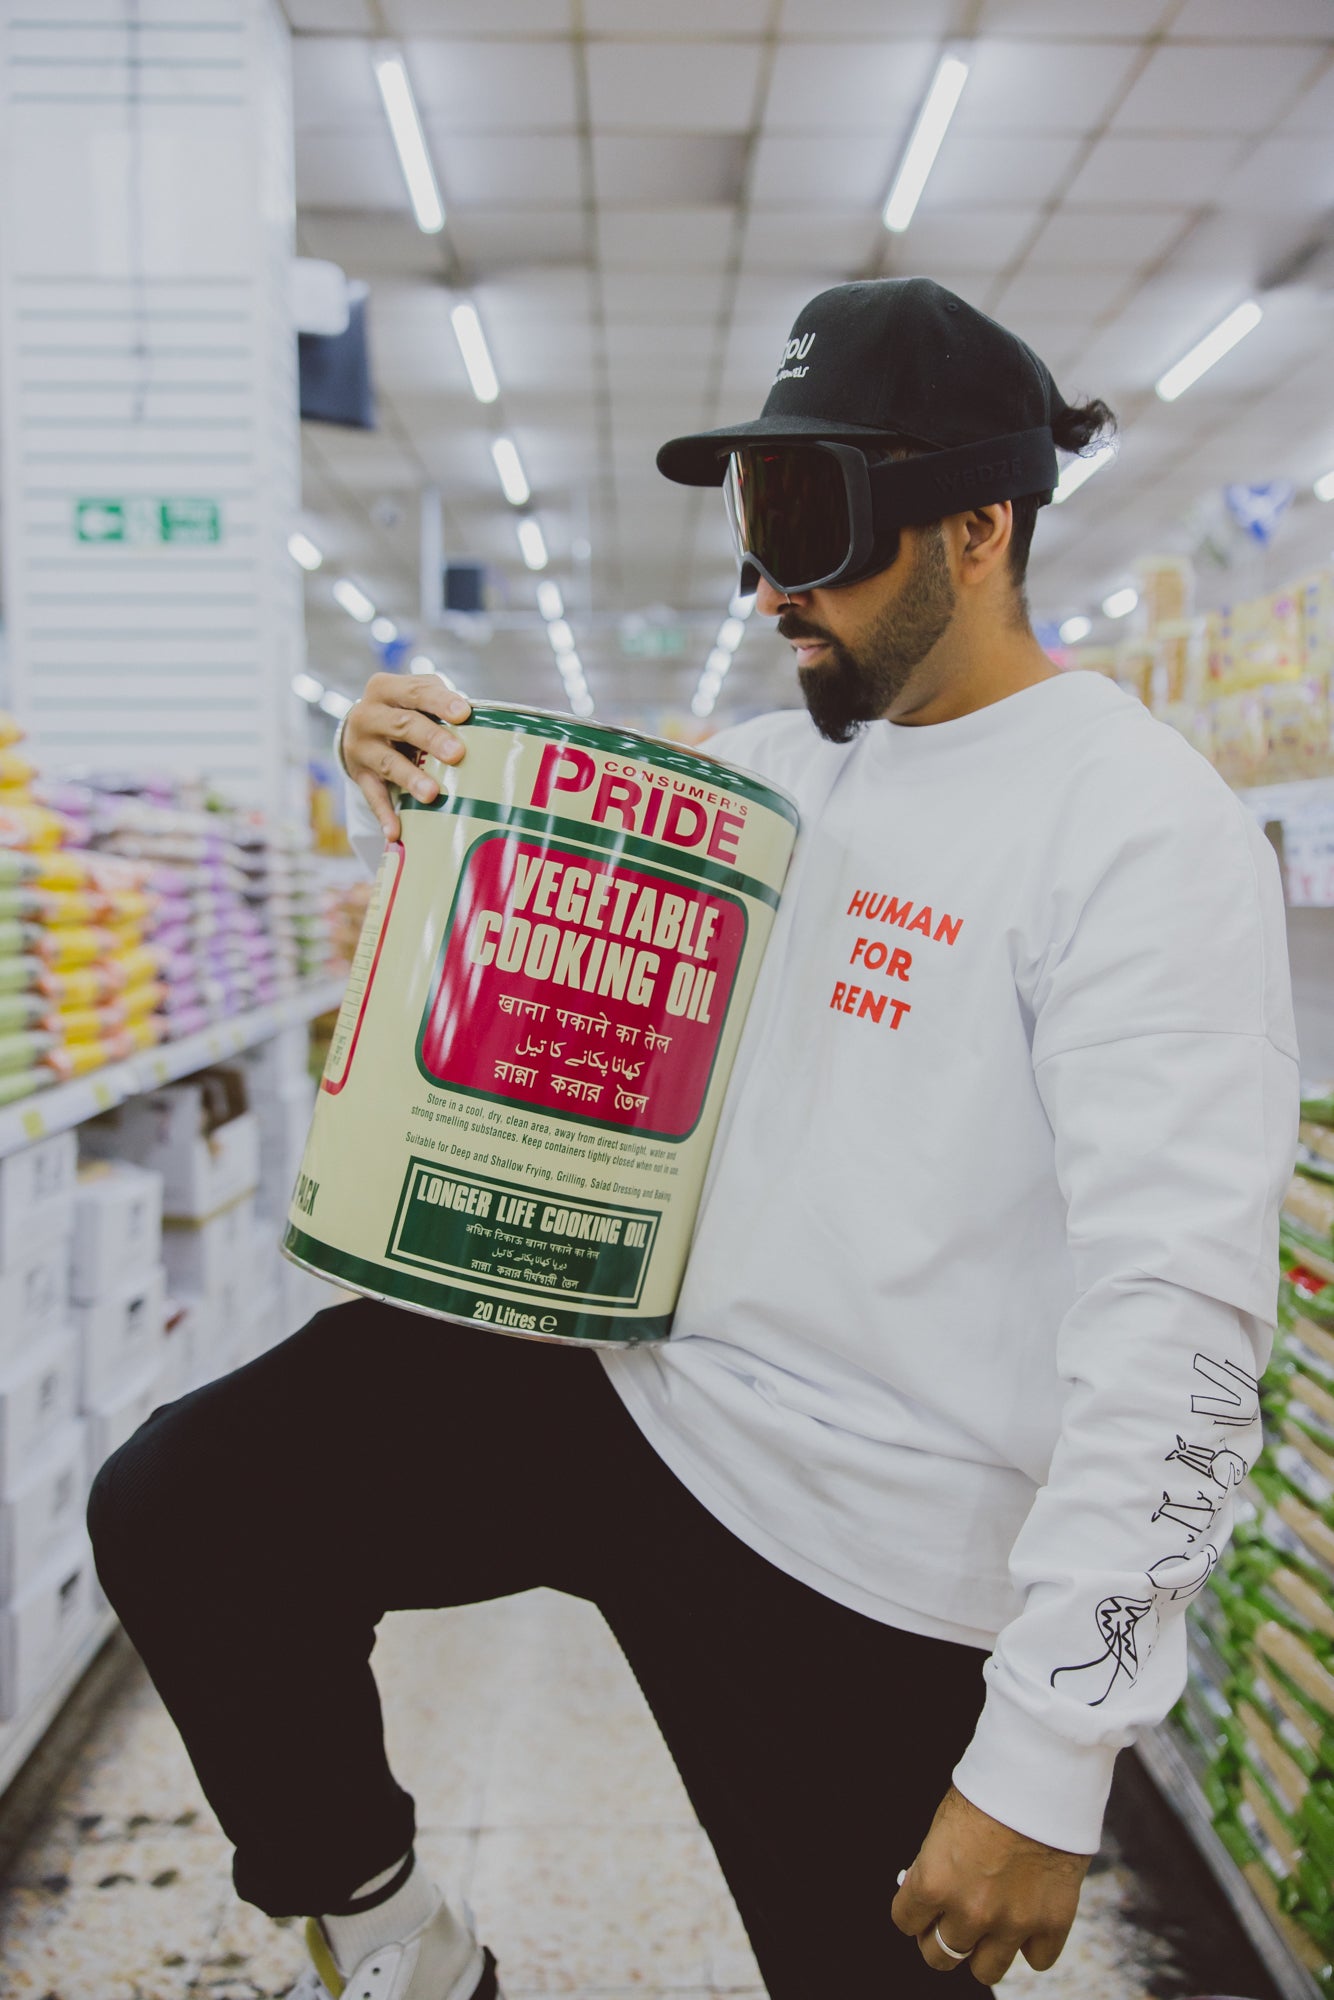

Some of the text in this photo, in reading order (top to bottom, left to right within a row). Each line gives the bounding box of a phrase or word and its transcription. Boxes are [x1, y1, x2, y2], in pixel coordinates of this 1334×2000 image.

[530, 743, 745, 865] PRIDE
[603, 761, 748, 816] CONSUMER'S
[512, 853, 719, 961] VEGETABLE
[847, 890, 964, 945] HUMAN
[467, 910, 661, 1008] COOKING
[665, 961, 717, 1024] OIL
[850, 938, 912, 982] FOR
[498, 994, 673, 1054] खाना पकाने का तेल
[830, 981, 911, 1030] RENT
[494, 1060, 650, 1114] রান্না করার তৈল
[411, 1105, 434, 1121] strong
[436, 1113, 469, 1131] smelling
[522, 1134, 543, 1148] Keep
[545, 1141, 585, 1158] containers
[588, 1149, 611, 1165] tightly
[613, 1156, 635, 1168] closed
[636, 1161, 652, 1172] when
[427, 1093, 446, 1107] Store
[449, 1100, 456, 1110] in
[506, 1115, 529, 1129] clean
[555, 1128, 575, 1141] away
[578, 1132, 595, 1144] from
[597, 1136, 618, 1150] direct
[406, 1132, 435, 1149] Suitable
[438, 1140, 448, 1152] for
[451, 1144, 471, 1160] Deep
[473, 1151, 488, 1163] and
[491, 1155, 523, 1172] Shallow
[591, 1178, 611, 1191] Salad
[613, 1183, 641, 1198] Dressing
[642, 1189, 653, 1199] and
[417, 1175, 648, 1249] LONGER LIFE COOKING OIL
[473, 1301, 493, 1320] 20
[495, 1305, 536, 1330] Litres
